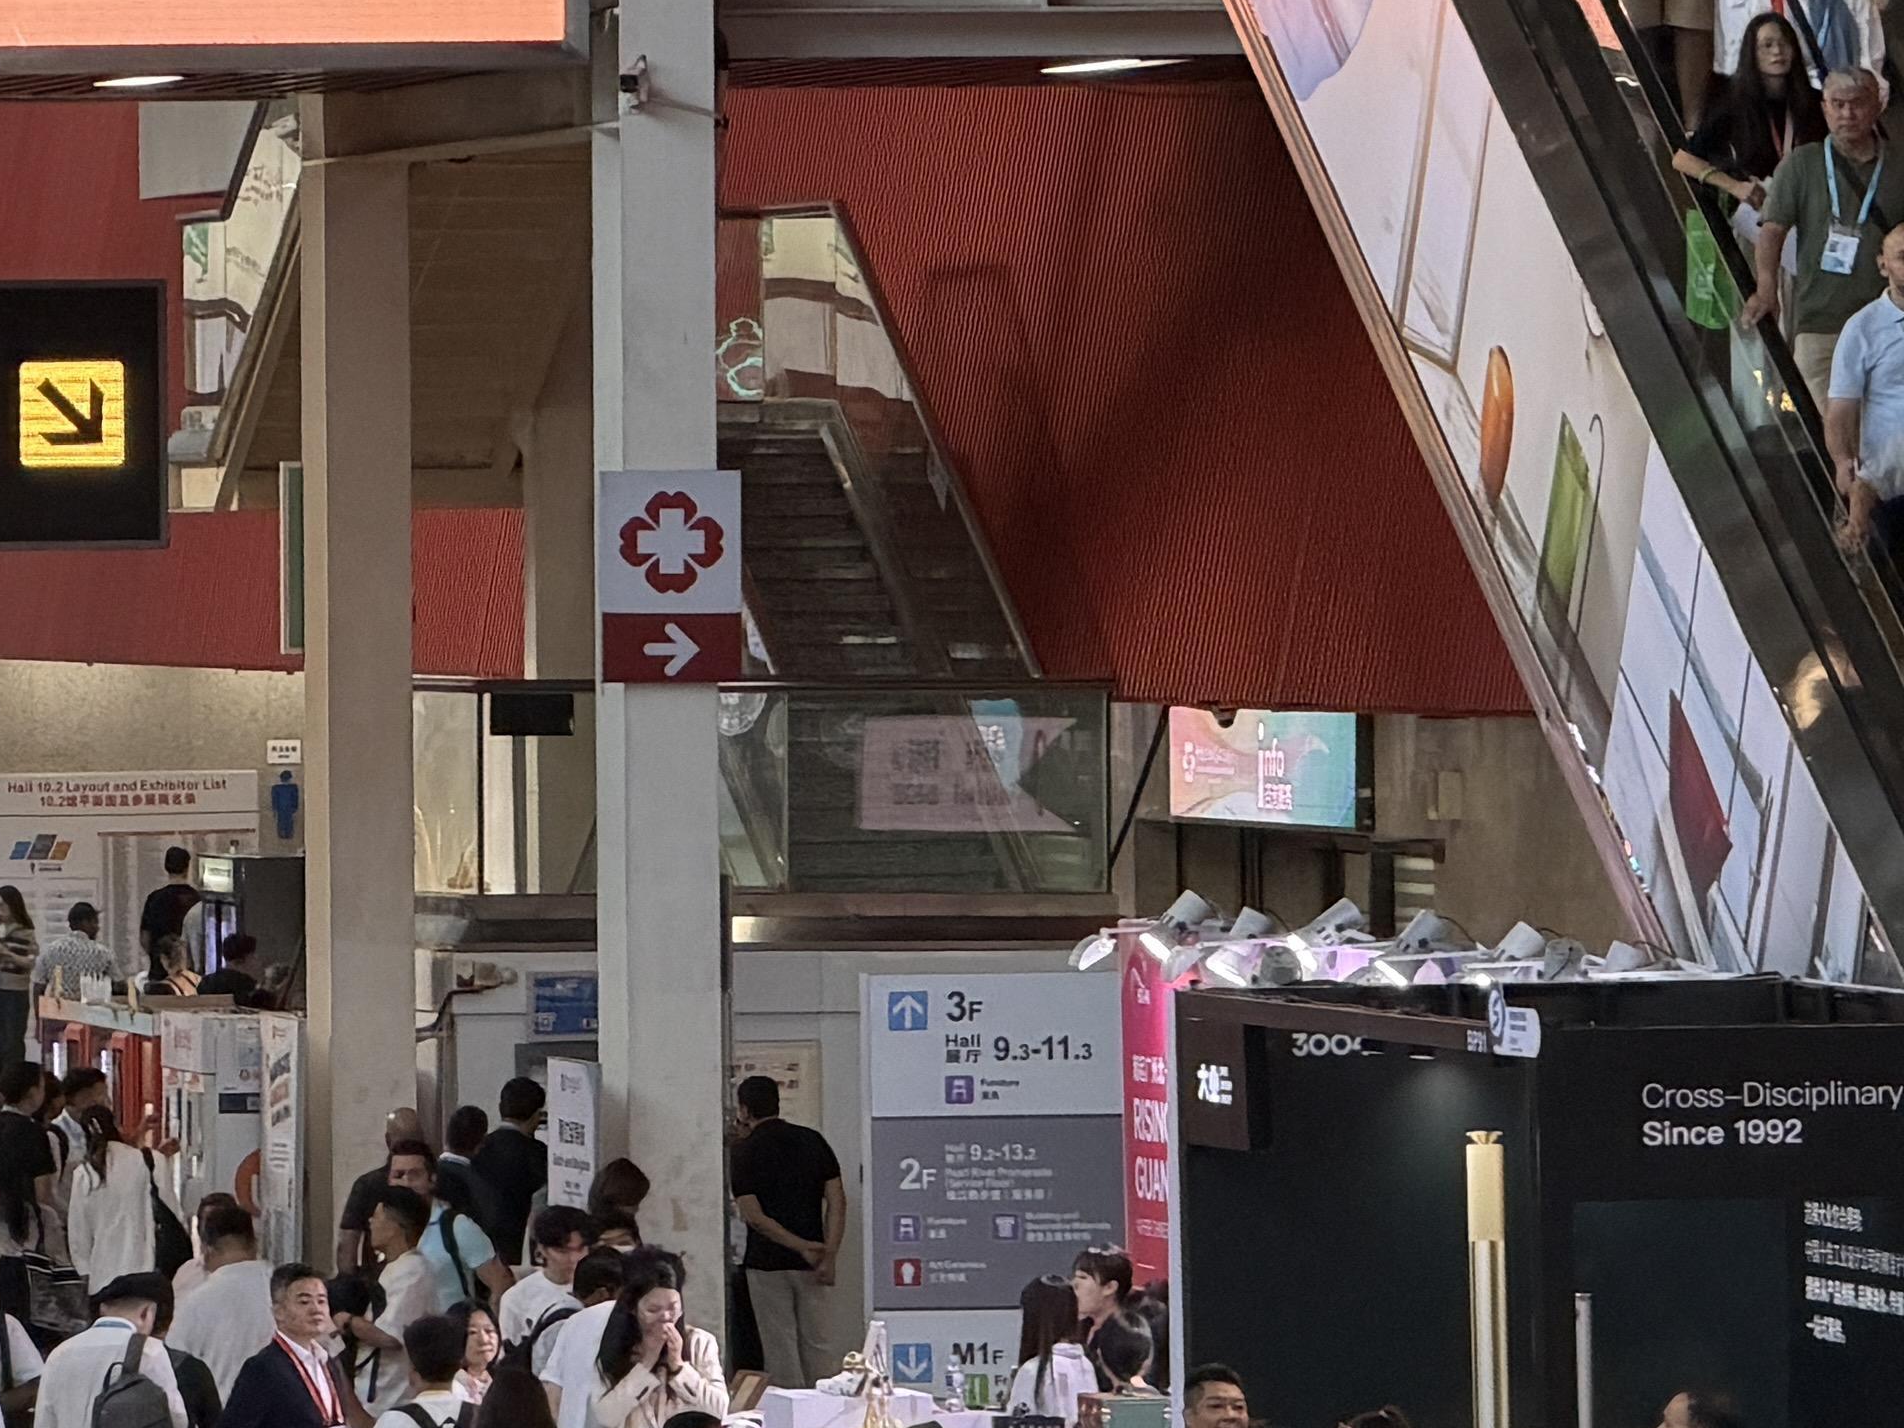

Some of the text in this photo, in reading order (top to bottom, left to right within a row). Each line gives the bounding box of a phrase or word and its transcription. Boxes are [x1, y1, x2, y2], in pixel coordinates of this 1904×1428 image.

[7, 779, 227, 794] Hall 10.2 Layout and Exhibitor List
[946, 990, 983, 1023] 3F
[945, 1034, 1093, 1062] Hall 9.3-11.3
[945, 1049, 982, 1064] 展厅
[1642, 1118, 1803, 1146] Since 1992
[969, 1144, 1037, 1162] 9.2-13.2
[899, 1158, 937, 1191] 2F
[953, 1343, 1004, 1365] M1F
